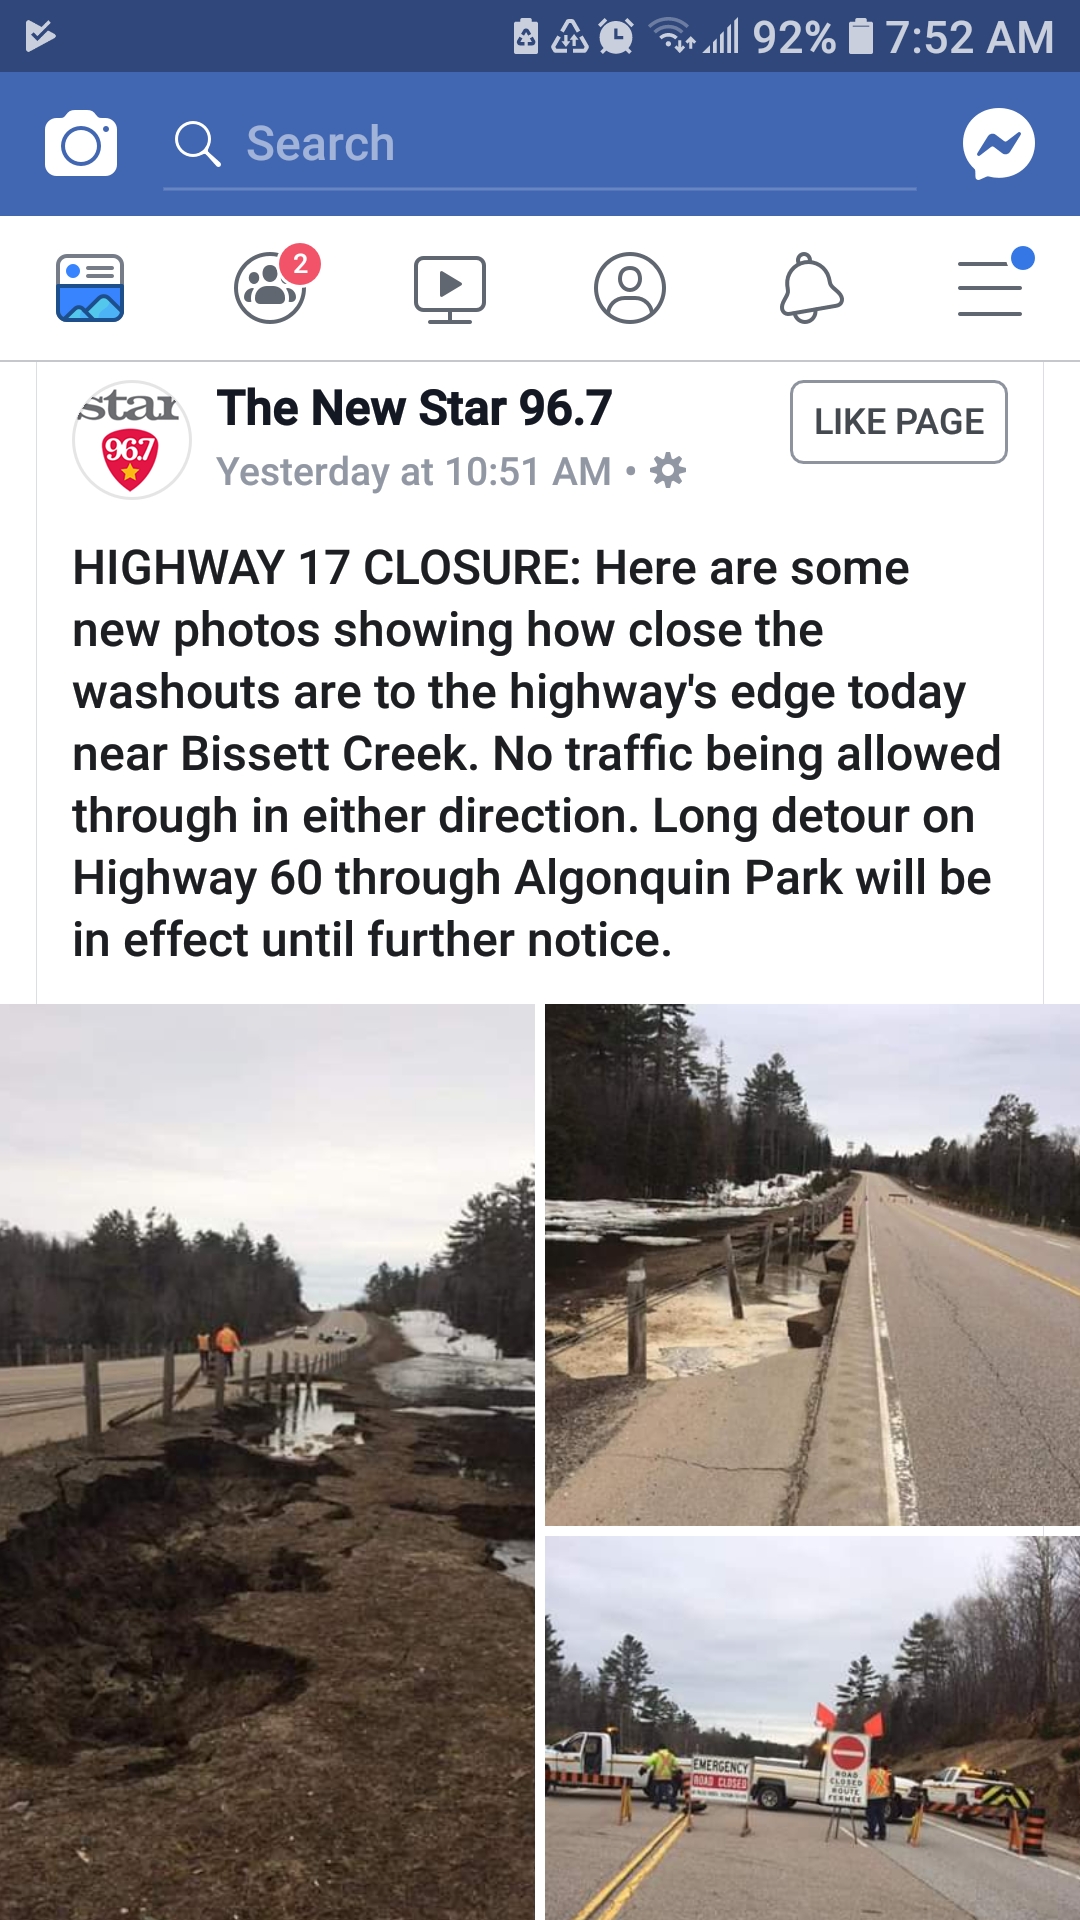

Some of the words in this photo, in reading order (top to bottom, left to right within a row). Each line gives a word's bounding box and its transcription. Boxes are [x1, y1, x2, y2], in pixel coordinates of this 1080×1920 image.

[754, 20, 836, 54] 92%
[886, 20, 973, 54] 7:52
[986, 21, 1052, 53] AM
[248, 124, 393, 160] Search
[293, 252, 309, 274] 2
[77, 389, 180, 421] star
[217, 387, 298, 426] The
[313, 389, 407, 426] New
[419, 389, 507, 426] Star
[520, 389, 612, 426] 96.7
[816, 408, 886, 434] LIKE
[897, 408, 984, 435] PAGE
[104, 437, 156, 461] 96.7
[216, 456, 389, 492] Yesterday
[402, 459, 433, 485] at
[447, 457, 535, 485] 10:51
[552, 457, 609, 485] AM
[75, 549, 285, 585] HIGHWAY
[301, 549, 350, 585] 17
[365, 549, 579, 585] CLOSURE:
[597, 550, 696, 585] Here
[711, 558, 777, 585] are
[791, 558, 909, 585] some
[74, 620, 160, 647] new
[176, 610, 319, 656] photos
[334, 610, 512, 656] showing
[528, 610, 615, 647] how
[630, 610, 742, 647] close
[755, 610, 823, 647] the
[73, 672, 279, 709] washouts
[295, 682, 361, 709] are
[374, 676, 415, 709] to
[428, 672, 496, 709] the
[511, 672, 716, 719] highway's
[732, 672, 835, 718] edge
[848, 672, 966, 719] today
[74, 744, 168, 771] near
[183, 735, 329, 771] Bissett
[344, 734, 477, 771] Creek.
[495, 736, 552, 771] No
[565, 733, 692, 771] traffic
[708, 734, 822, 780] being
[838, 734, 999, 771] allowed
[72, 796, 236, 842] through
[254, 797, 287, 832] in
[304, 796, 426, 833] either
[440, 796, 637, 833] direction.
[655, 798, 757, 842] Long
[773, 796, 910, 833] detour
[924, 806, 973, 833] on
[75, 858, 257, 905] Highway
[271, 859, 321, 895] 60
[335, 858, 499, 904] through
[514, 858, 729, 904] Algonquin
[747, 858, 843, 895] Park
[856, 858, 924, 894] will
[942, 858, 991, 895] be
[75, 921, 108, 956] in
[125, 919, 248, 957] effect
[263, 920, 352, 957] until
[368, 919, 515, 957] further
[529, 921, 670, 957] notice.
[693, 1758, 748, 1775] EMERGENCY
[693, 1774, 714, 1787] ROAD
[718, 1776, 747, 1789] CLOSED
[830, 1777, 863, 1787] CLOSED
[835, 1770, 859, 1779] ROAD
[832, 1787, 860, 1796] ROUTE
